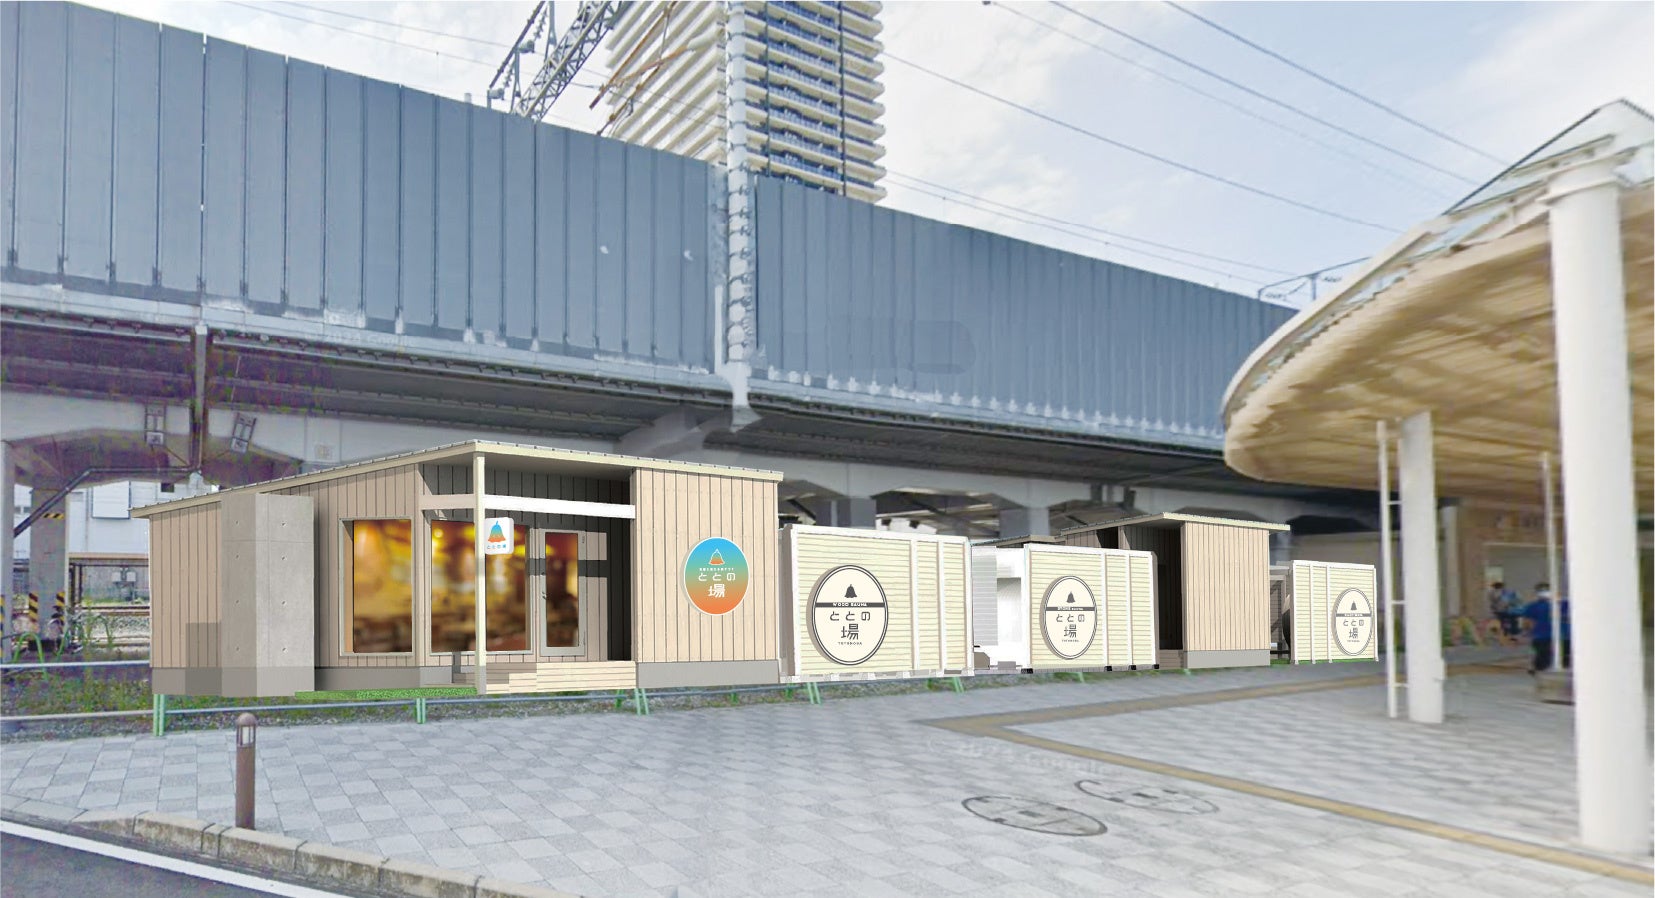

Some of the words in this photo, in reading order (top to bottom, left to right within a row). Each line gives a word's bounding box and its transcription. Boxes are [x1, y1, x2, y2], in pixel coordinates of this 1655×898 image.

[698, 572, 736, 582] ととの
[707, 583, 726, 598] 場
[829, 610, 871, 621] ととの
[1055, 613, 1085, 623] ととの
[840, 623, 860, 640] 場
[1063, 623, 1077, 638] 場
